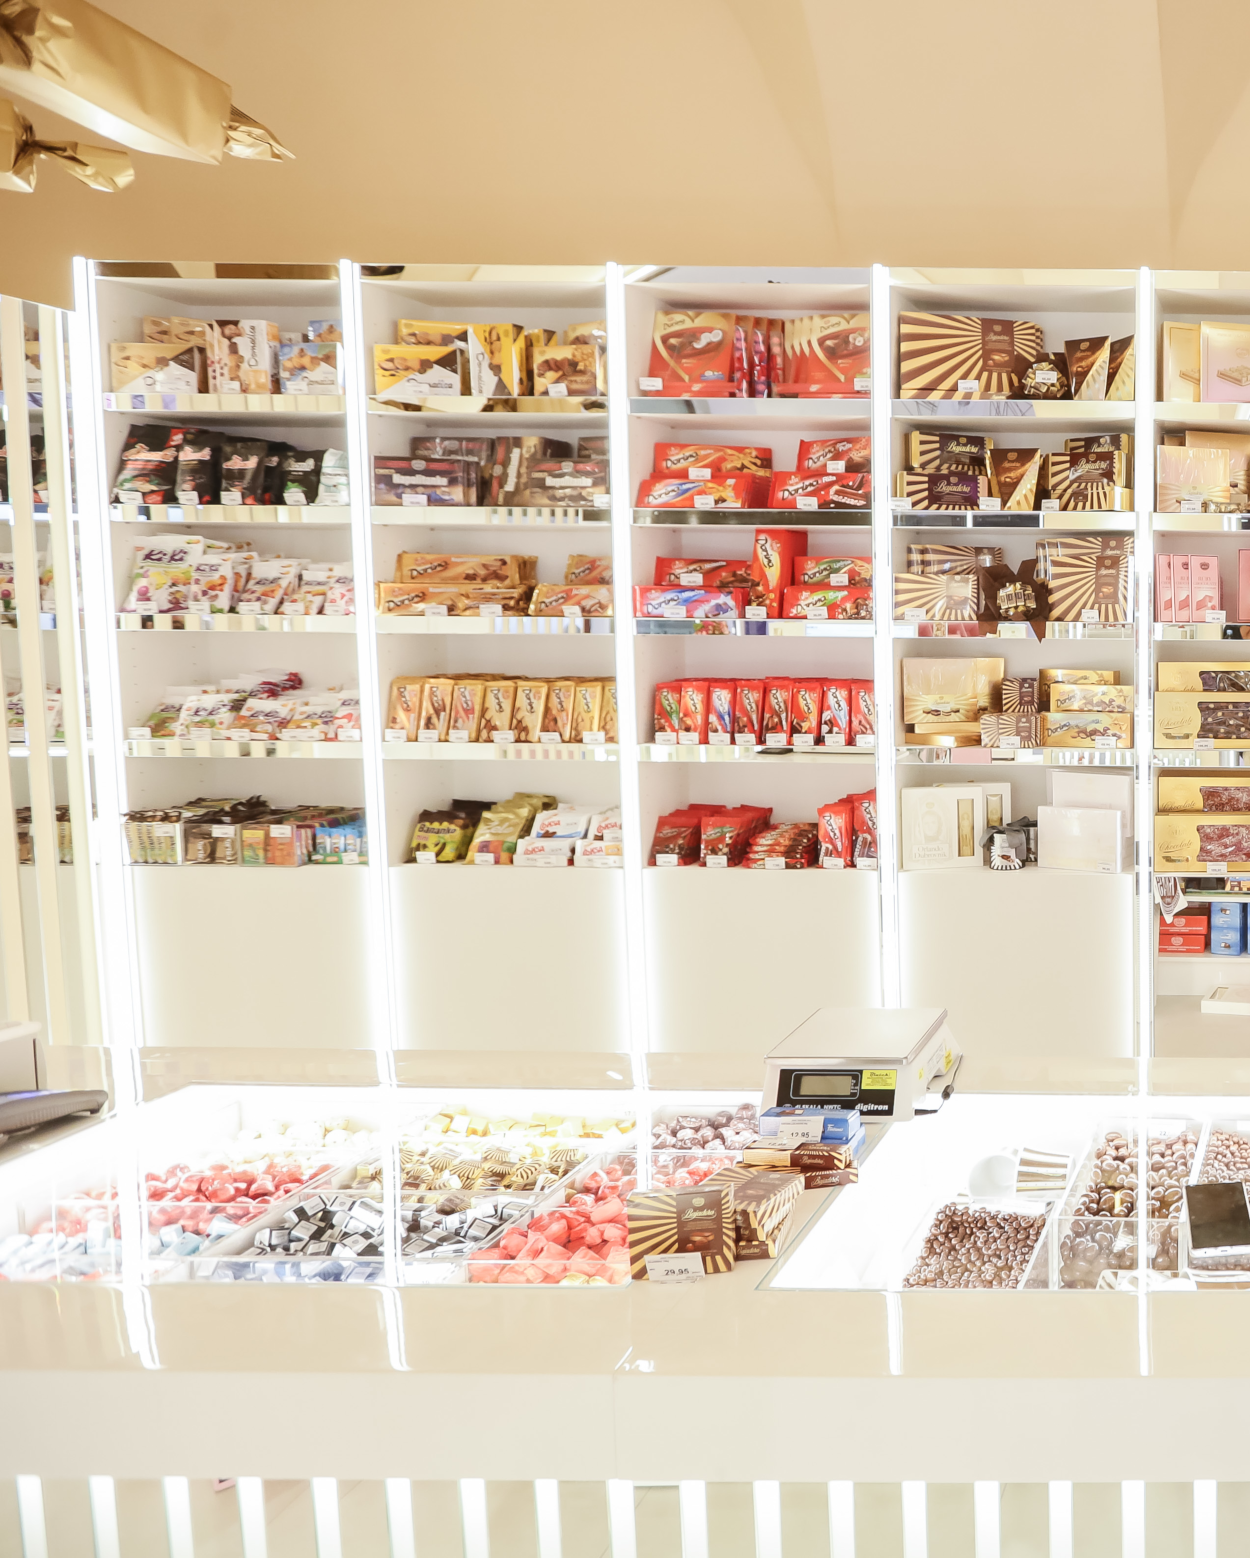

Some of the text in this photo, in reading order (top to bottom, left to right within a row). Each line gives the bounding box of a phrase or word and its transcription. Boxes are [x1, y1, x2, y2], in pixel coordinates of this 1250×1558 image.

[944, 439, 980, 455] Bajadera
[664, 451, 699, 469] Dorina
[806, 445, 836, 471] Dorina
[1075, 458, 1111, 473] Bajadera
[647, 486, 680, 504] Dorina
[781, 480, 819, 501] Dorina
[932, 479, 973, 496] Bajadera
[756, 536, 774, 570] Dorina
[409, 560, 449, 580] Dorina
[668, 564, 703, 583] Dorina
[802, 564, 832, 584] Dorina
[385, 591, 426, 611] Dorina
[646, 594, 680, 614] Dorina
[770, 687, 783, 714] Dorina
[799, 688, 812, 715] Dorina
[829, 686, 843, 713] Dorina
[858, 690, 873, 717] Dorina
[1157, 717, 1194, 729] Chocolate
[418, 823, 457, 834] Bananko
[1157, 840, 1194, 853] Chocolate
[855, 1103, 889, 1111] digitron
[681, 1207, 717, 1221] Bajadera
[664, 1268, 690, 1277] 29,95
